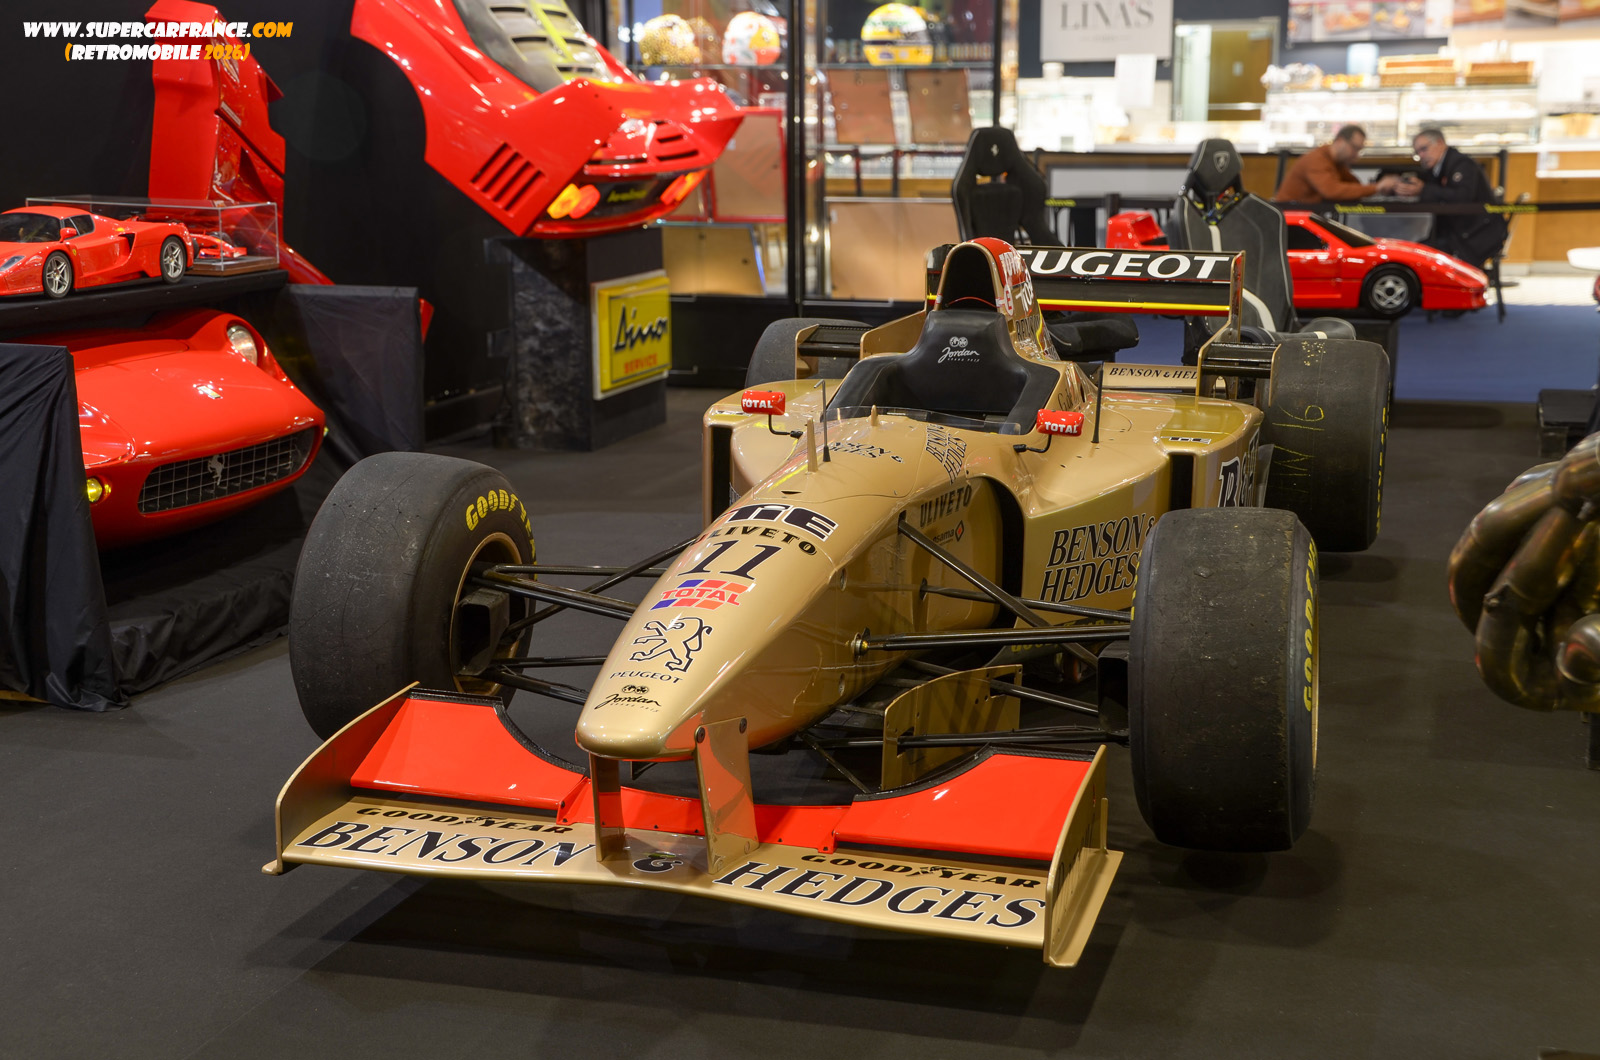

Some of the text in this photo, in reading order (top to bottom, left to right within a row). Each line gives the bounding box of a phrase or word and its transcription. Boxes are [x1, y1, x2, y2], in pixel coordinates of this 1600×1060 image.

[1018, 249, 1230, 280] UGEOT
[613, 303, 668, 352] Dino
[937, 346, 980, 364] Jordan
[1109, 366, 1162, 378] BENSON
[1163, 370, 1170, 378] &
[742, 397, 774, 409] TOTAL
[1044, 421, 1078, 434] TOTAL
[920, 484, 973, 529] ULIVETO
[1046, 512, 1146, 569] BENSON
[677, 540, 783, 581] 11
[1040, 551, 1140, 604] HEDGES
[661, 587, 741, 607] TOTAL
[610, 670, 684, 685] PEUGEOT
[594, 693, 662, 710] Jordan
[295, 821, 597, 868] BENSON
[713, 860, 1047, 930] HEDGES
